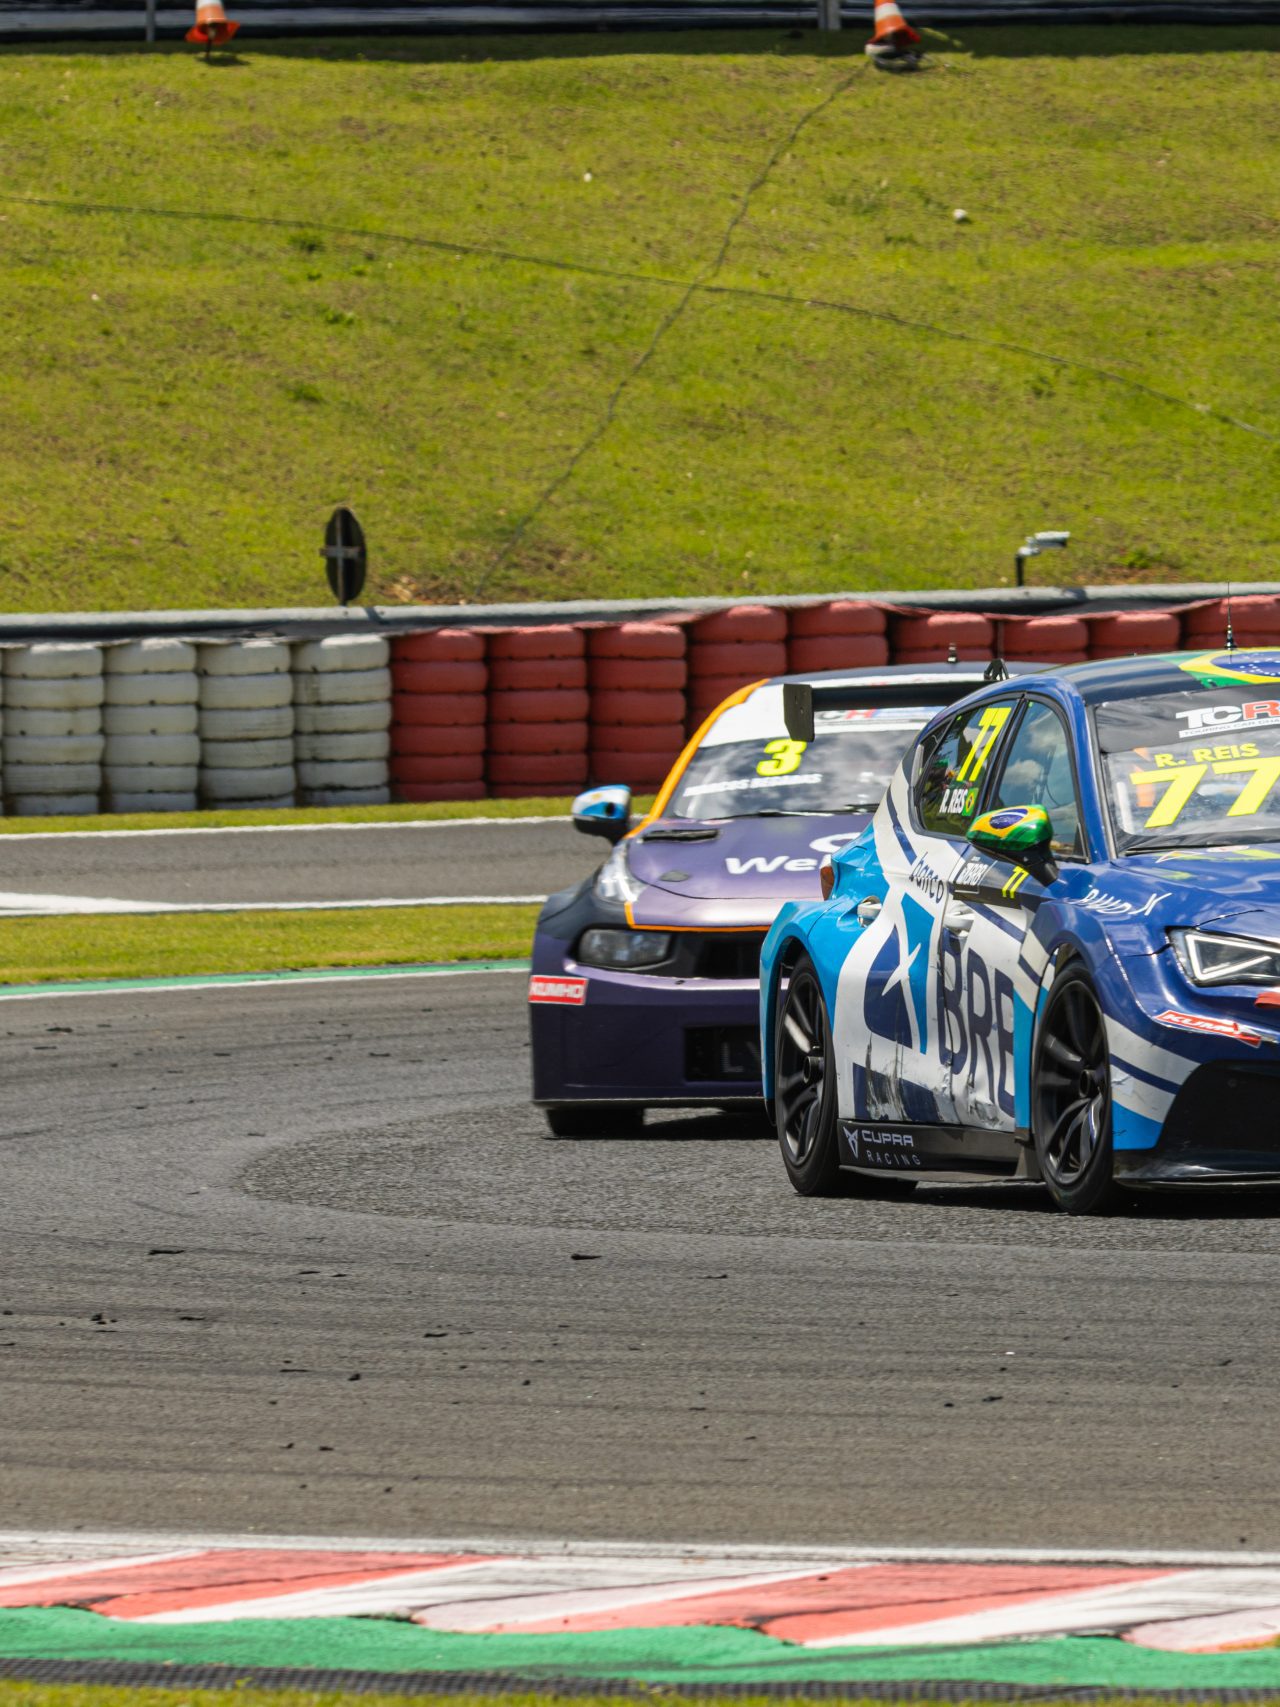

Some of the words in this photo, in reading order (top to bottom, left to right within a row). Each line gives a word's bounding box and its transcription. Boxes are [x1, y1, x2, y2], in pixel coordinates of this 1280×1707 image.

[1232, 721, 1257, 729] CAR
[757, 738, 807, 776] 3
[957, 708, 1012, 781] 77
[1154, 753, 1187, 768] R.
[1192, 743, 1260, 763] REIS
[939, 789, 949, 814] R.
[949, 788, 968, 814] REIS
[908, 852, 944, 905] banco
[1002, 865, 1030, 899] 77
[530, 981, 584, 999] KUMHO
[1163, 1013, 1240, 1035] KUM
[861, 1129, 914, 1148] CUPRA
[866, 1149, 921, 1166] RACING
